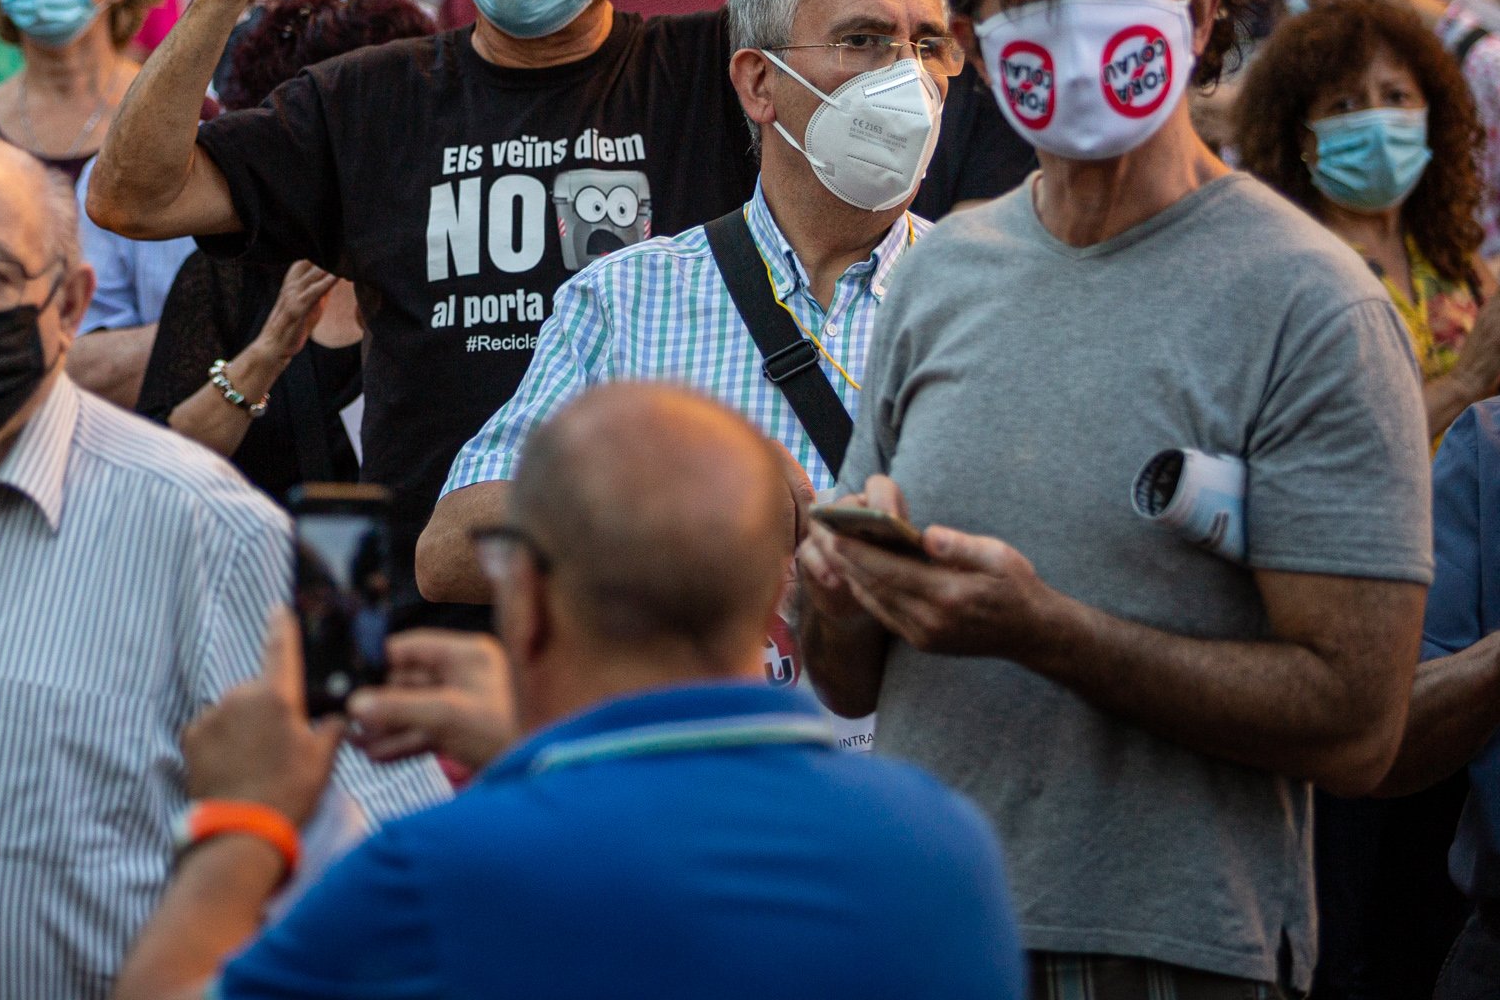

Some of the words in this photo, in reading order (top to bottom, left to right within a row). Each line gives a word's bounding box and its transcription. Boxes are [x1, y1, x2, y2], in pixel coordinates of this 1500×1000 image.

[1102, 36, 1167, 84] COLAU
[1113, 66, 1168, 104] FORA
[442, 145, 483, 175] Els
[491, 134, 568, 169] veïns
[574, 128, 646, 162] diem
[426, 174, 547, 283] NO
[430, 294, 456, 329] al
[463, 288, 544, 328] porta
